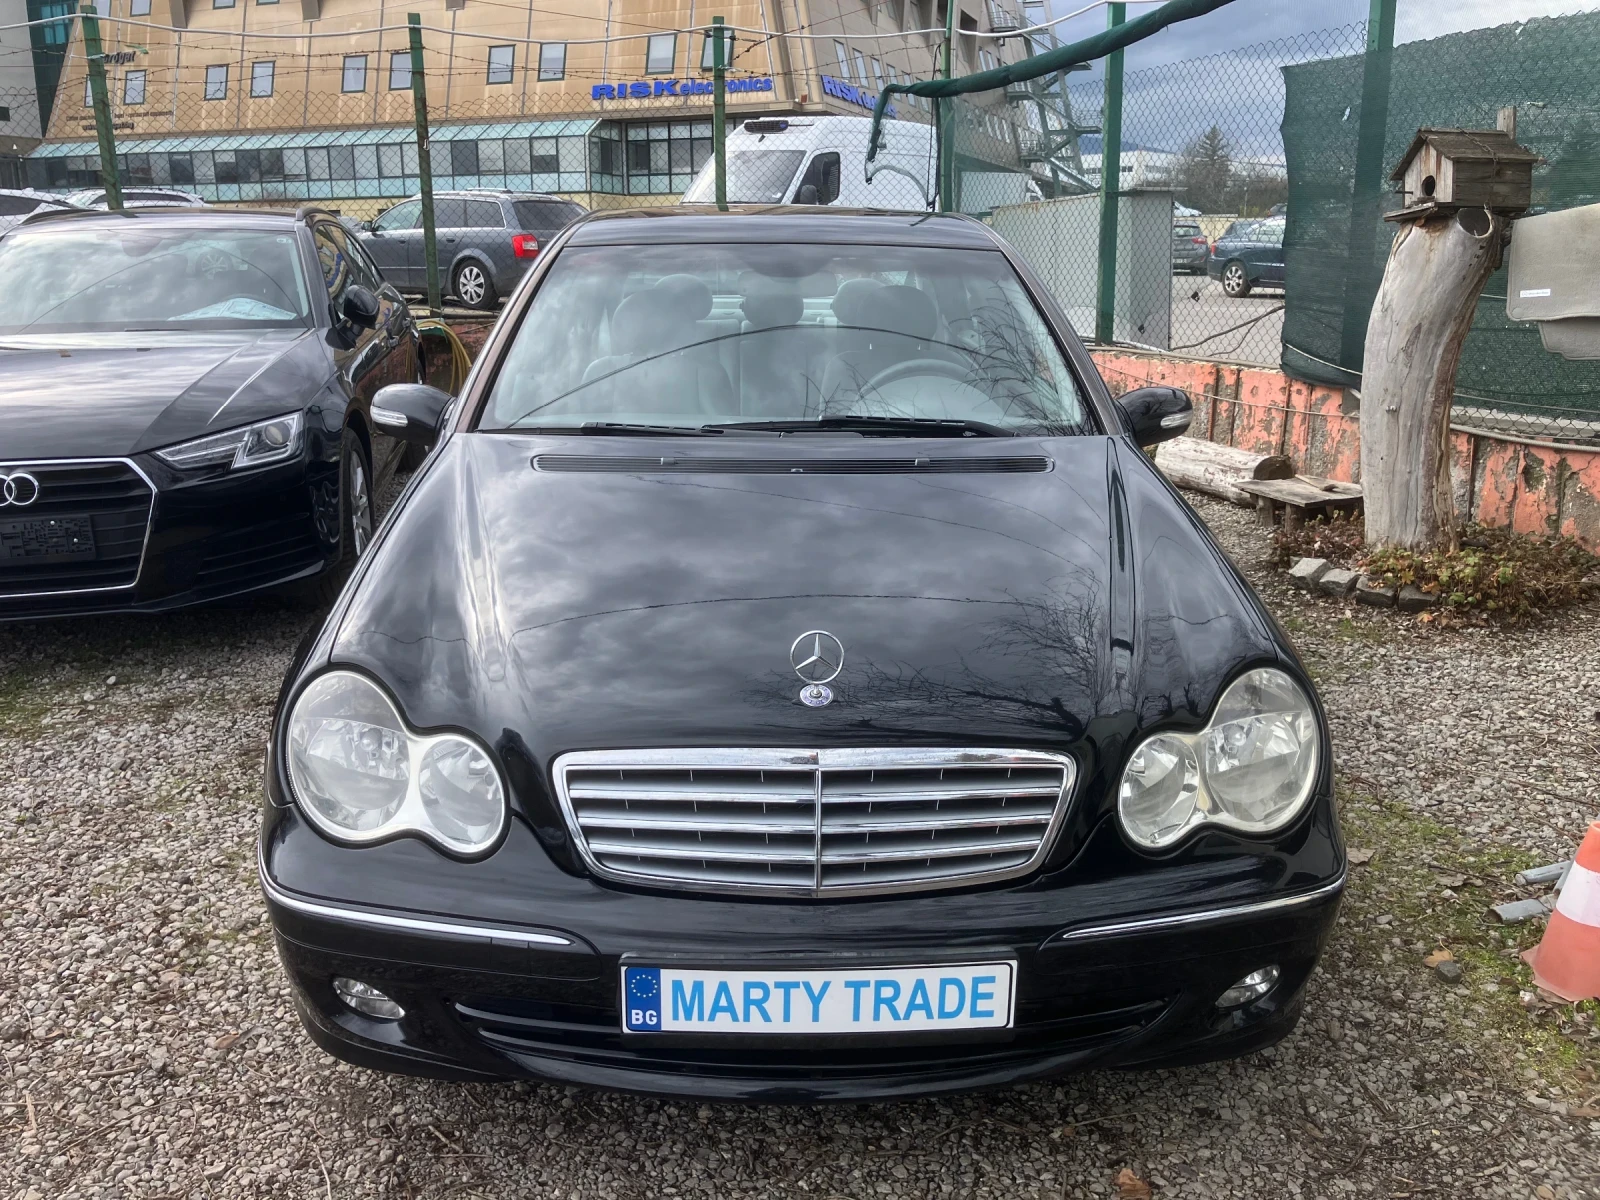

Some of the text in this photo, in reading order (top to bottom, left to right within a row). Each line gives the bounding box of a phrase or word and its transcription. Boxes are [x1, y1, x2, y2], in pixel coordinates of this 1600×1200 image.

[680, 76, 772, 95] eleconics
[671, 975, 997, 1023] MARTY TRADE
[631, 1009, 658, 1025] BG
